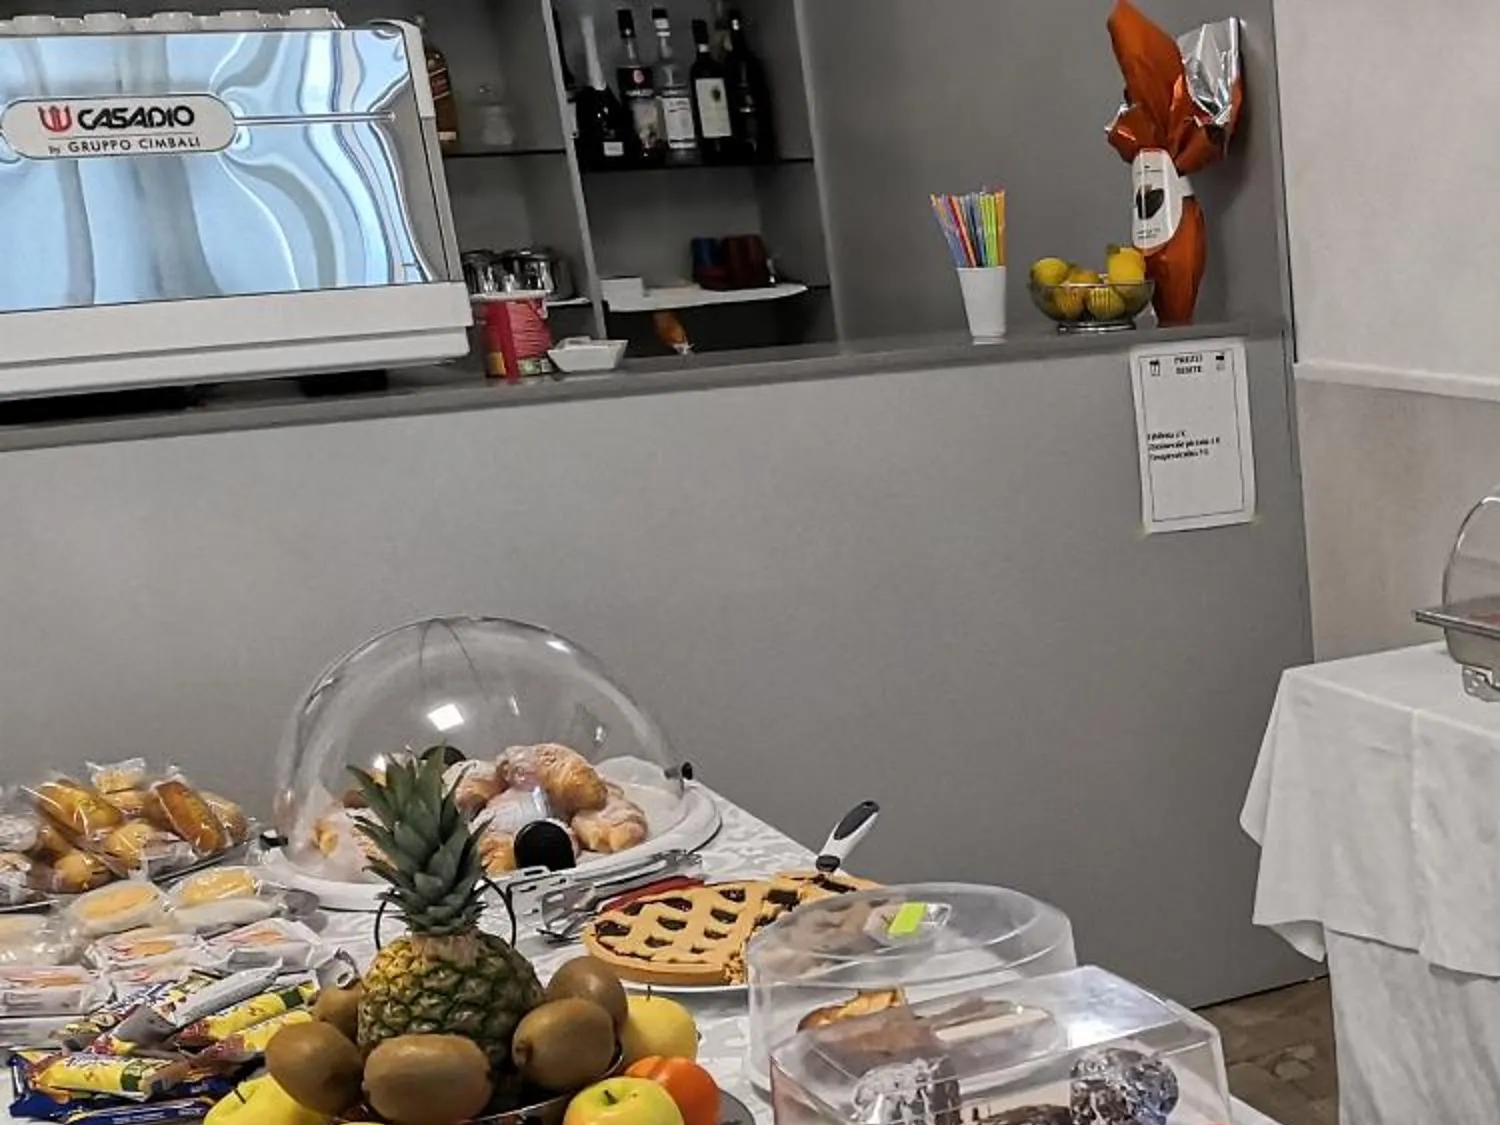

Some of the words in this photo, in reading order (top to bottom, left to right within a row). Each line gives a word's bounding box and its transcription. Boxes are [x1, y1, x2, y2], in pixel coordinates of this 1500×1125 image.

[77, 105, 195, 131] CASADIO
[67, 139, 131, 153] GRUPPO
[138, 137, 201, 149] CIMBALI
